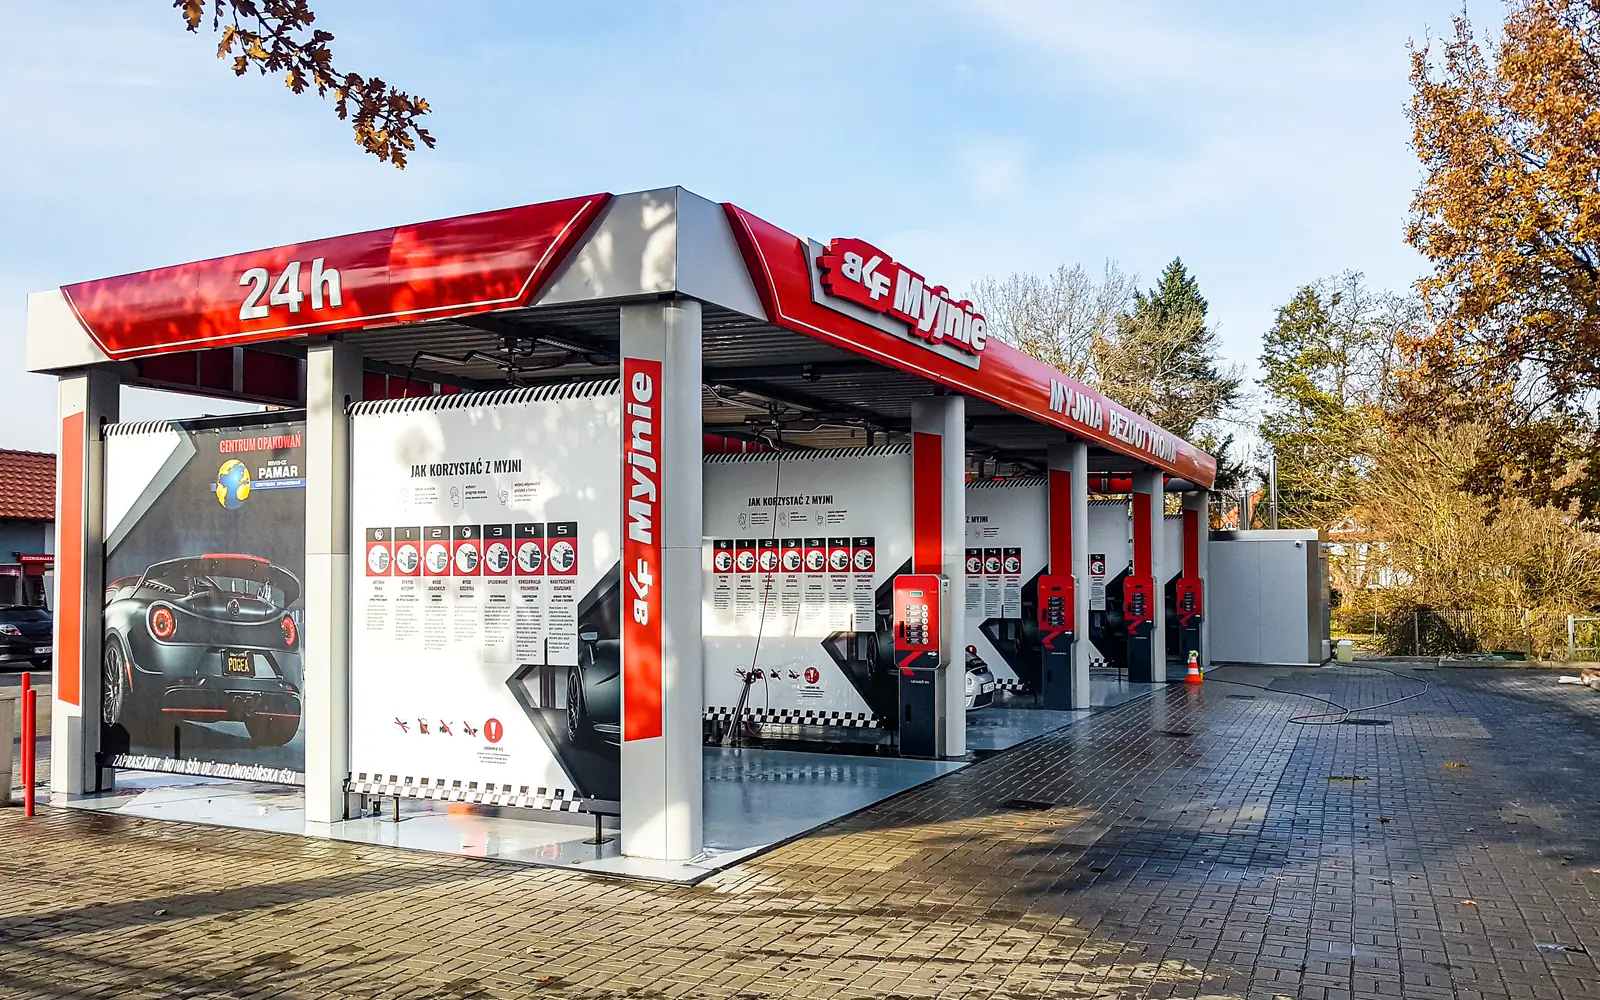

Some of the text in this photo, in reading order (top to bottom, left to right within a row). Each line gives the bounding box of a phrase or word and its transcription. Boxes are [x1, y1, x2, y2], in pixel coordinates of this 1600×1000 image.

[892, 268, 988, 351] Myjnie
[1049, 378, 1178, 464] MYJNIA BEZDOTYKOWA
[219, 430, 302, 454] CENTRUM OPAKOWAŃ
[627, 370, 658, 546] Myjnie
[258, 465, 298, 480] PAMAR
[410, 457, 522, 478] JAK KORZYSTAĆ Z MYJNI
[748, 494, 833, 506] JAK KORZYSTAĆ Z MYJNI
[405, 529, 410, 538] 1
[432, 529, 442, 538] 2
[493, 527, 503, 536] 3
[557, 526, 567, 534] 5
[228, 657, 249, 672] POGEA
[112, 754, 160, 770] ZAPRASZAMY
[162, 757, 184, 773] NOWA
[185, 757, 200, 774] SÓL
[213, 762, 278, 782] ZIELONOGÓRSKA
[279, 768, 296, 784] 63A
